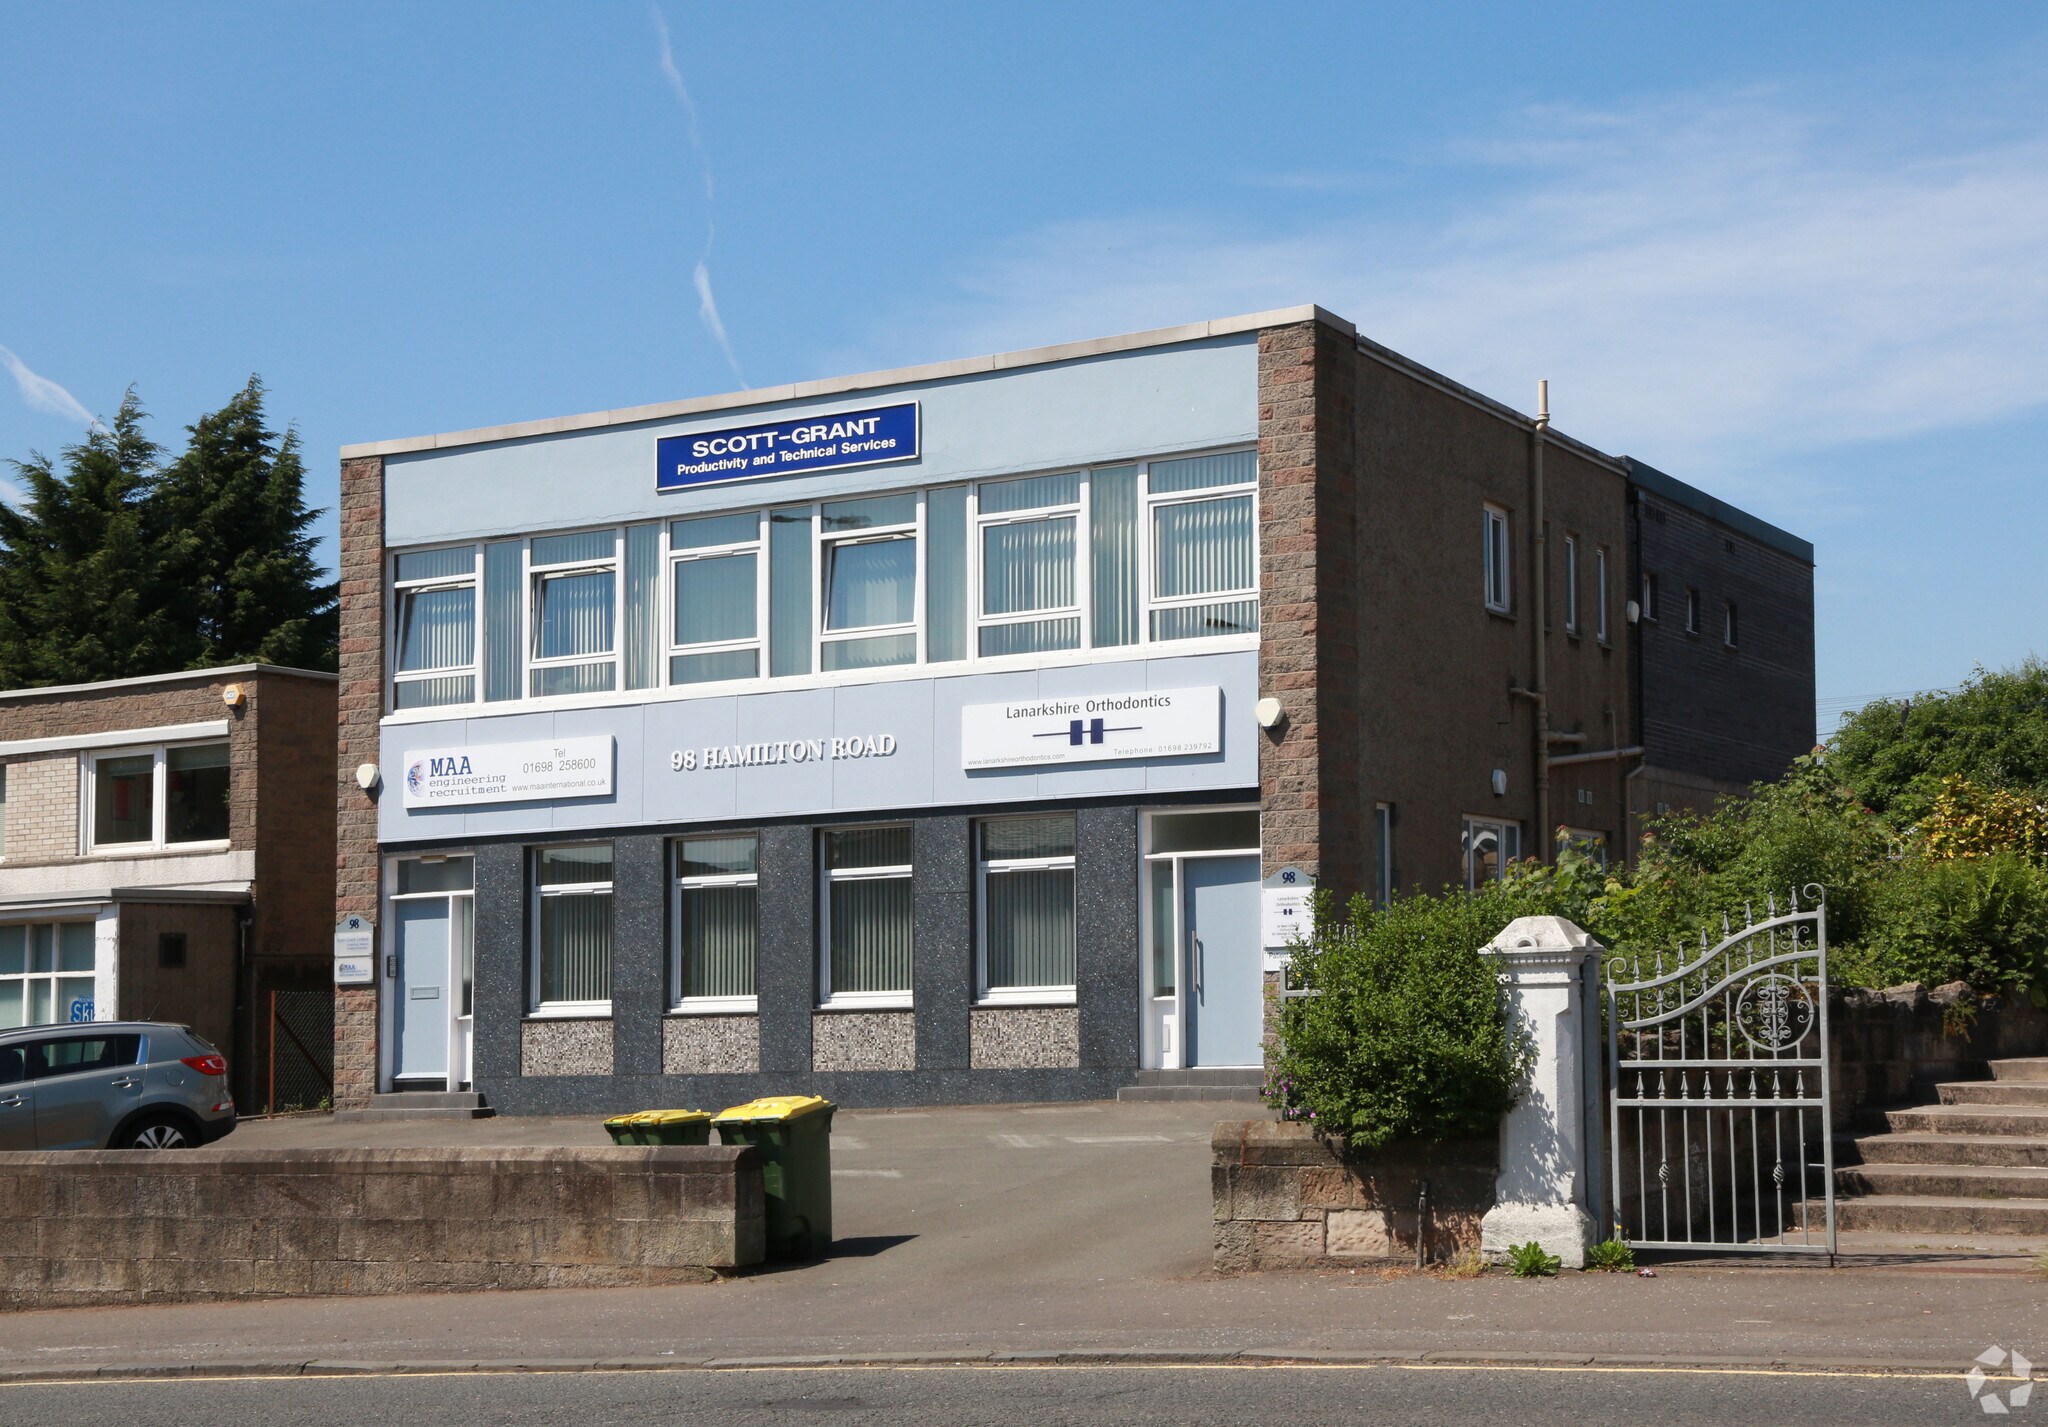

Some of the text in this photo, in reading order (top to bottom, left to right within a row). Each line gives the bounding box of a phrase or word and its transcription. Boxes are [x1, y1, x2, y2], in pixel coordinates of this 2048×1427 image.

[692, 416, 881, 458] SCOTT-GRANT
[677, 438, 896, 476] Productivity and Technical Services
[1006, 694, 1171, 719] Lanarkshire Orthodontics
[553, 748, 566, 758] Tel
[670, 734, 896, 771] 98 HAMILTON ROAD
[1158, 744, 1182, 753] 01698
[1184, 742, 1212, 751] 239792
[429, 755, 473, 777] MAA
[522, 757, 596, 774] 01698 258600
[967, 752, 1066, 766] www.lanarkshireorthodontics.com
[429, 773, 507, 787] engineering
[429, 784, 508, 798] recruitment
[1281, 871, 1296, 884] 98
[349, 918, 360, 930] 98
